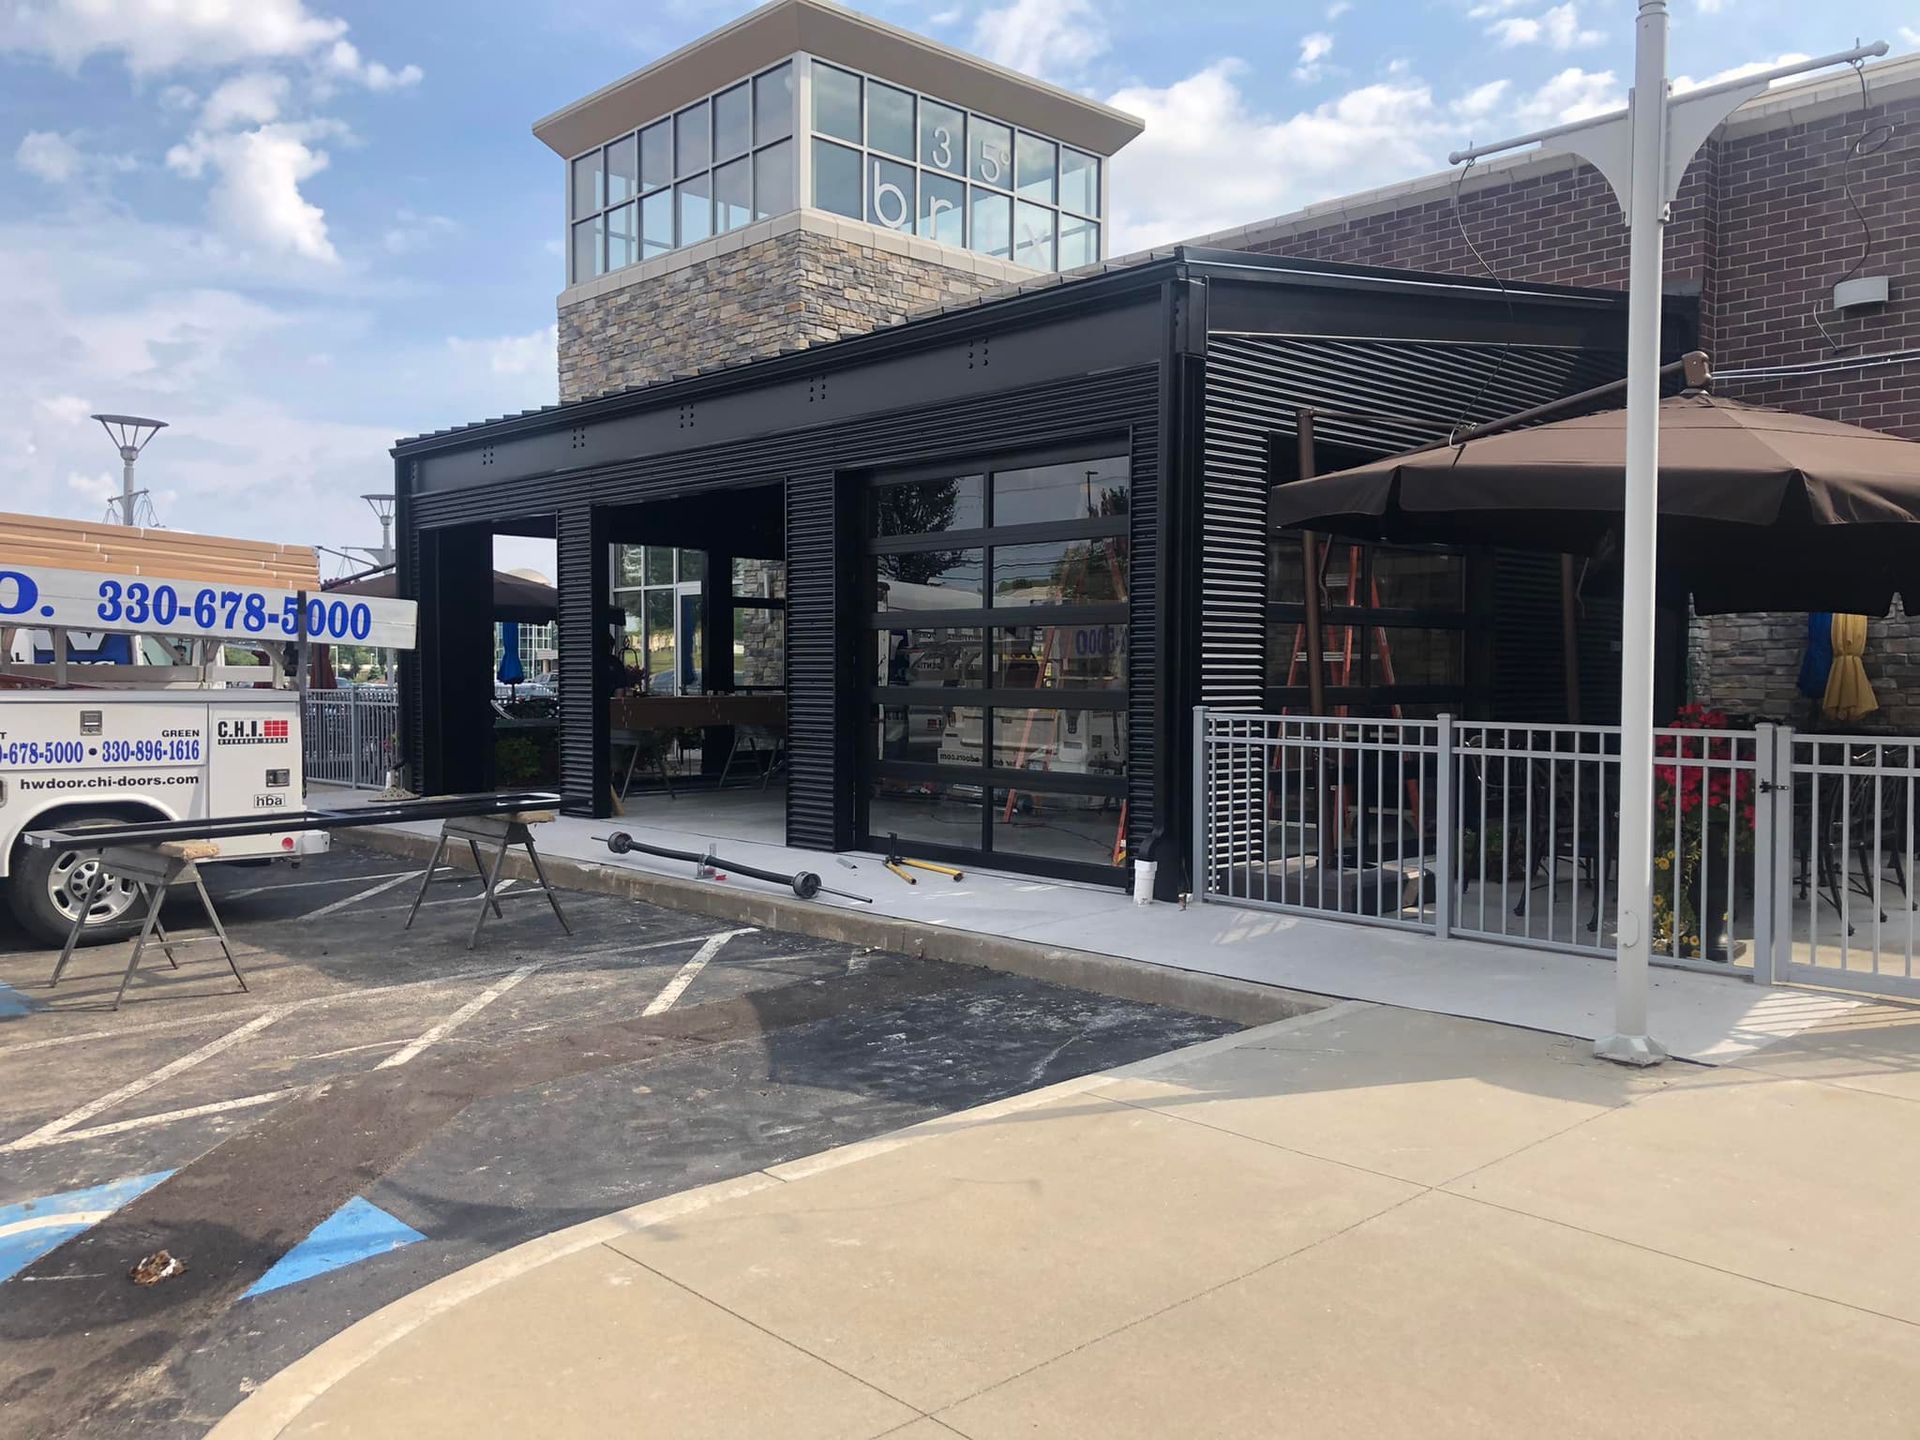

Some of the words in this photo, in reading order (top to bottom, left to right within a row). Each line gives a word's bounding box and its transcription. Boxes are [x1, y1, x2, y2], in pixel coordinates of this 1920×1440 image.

[97, 580, 372, 641] 330-678-5000
[162, 729, 200, 738] GREEN
[0, 741, 84, 765] -678-5000
[102, 739, 200, 763] 330-896-1616
[20, 775, 200, 790] hwdoor.chi-doors.com
